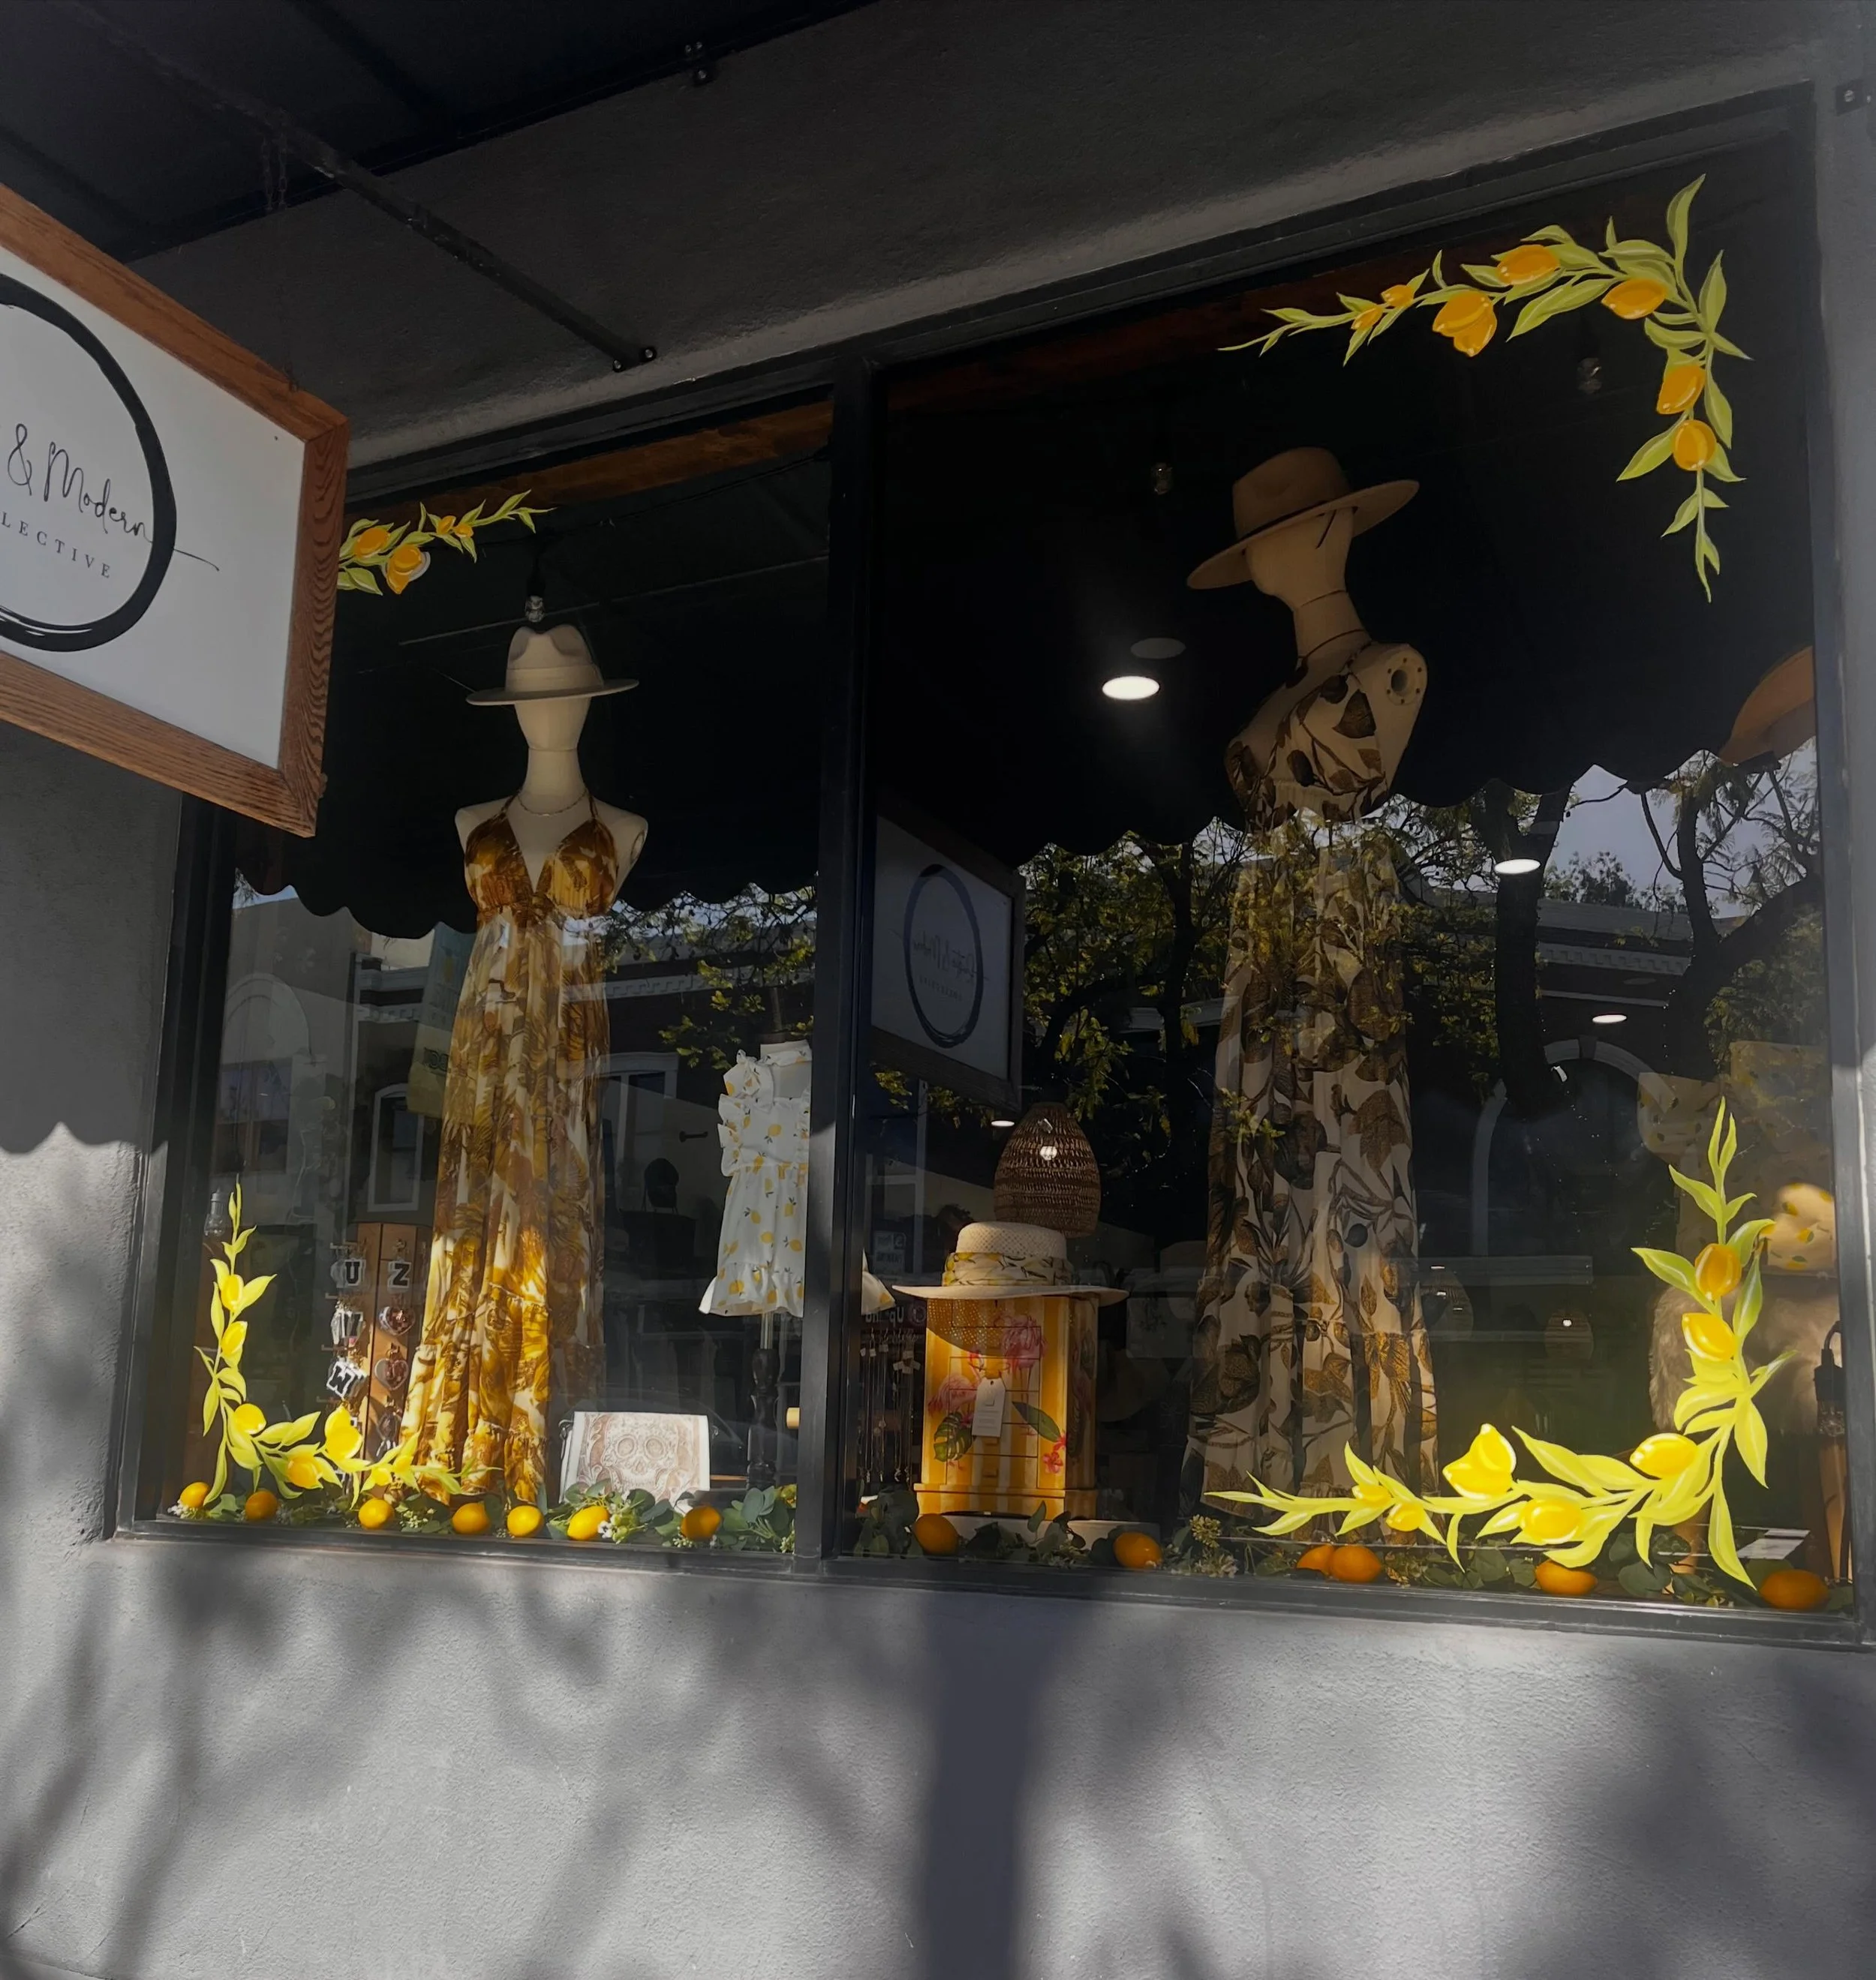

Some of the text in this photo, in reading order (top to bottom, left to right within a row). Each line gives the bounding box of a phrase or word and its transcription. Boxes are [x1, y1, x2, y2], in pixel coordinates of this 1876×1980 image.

[7, 422, 155, 543] & Modern
[1, 511, 111, 579] LECTIVE
[344, 1260, 361, 1285] U
[392, 1262, 412, 1287] Z
